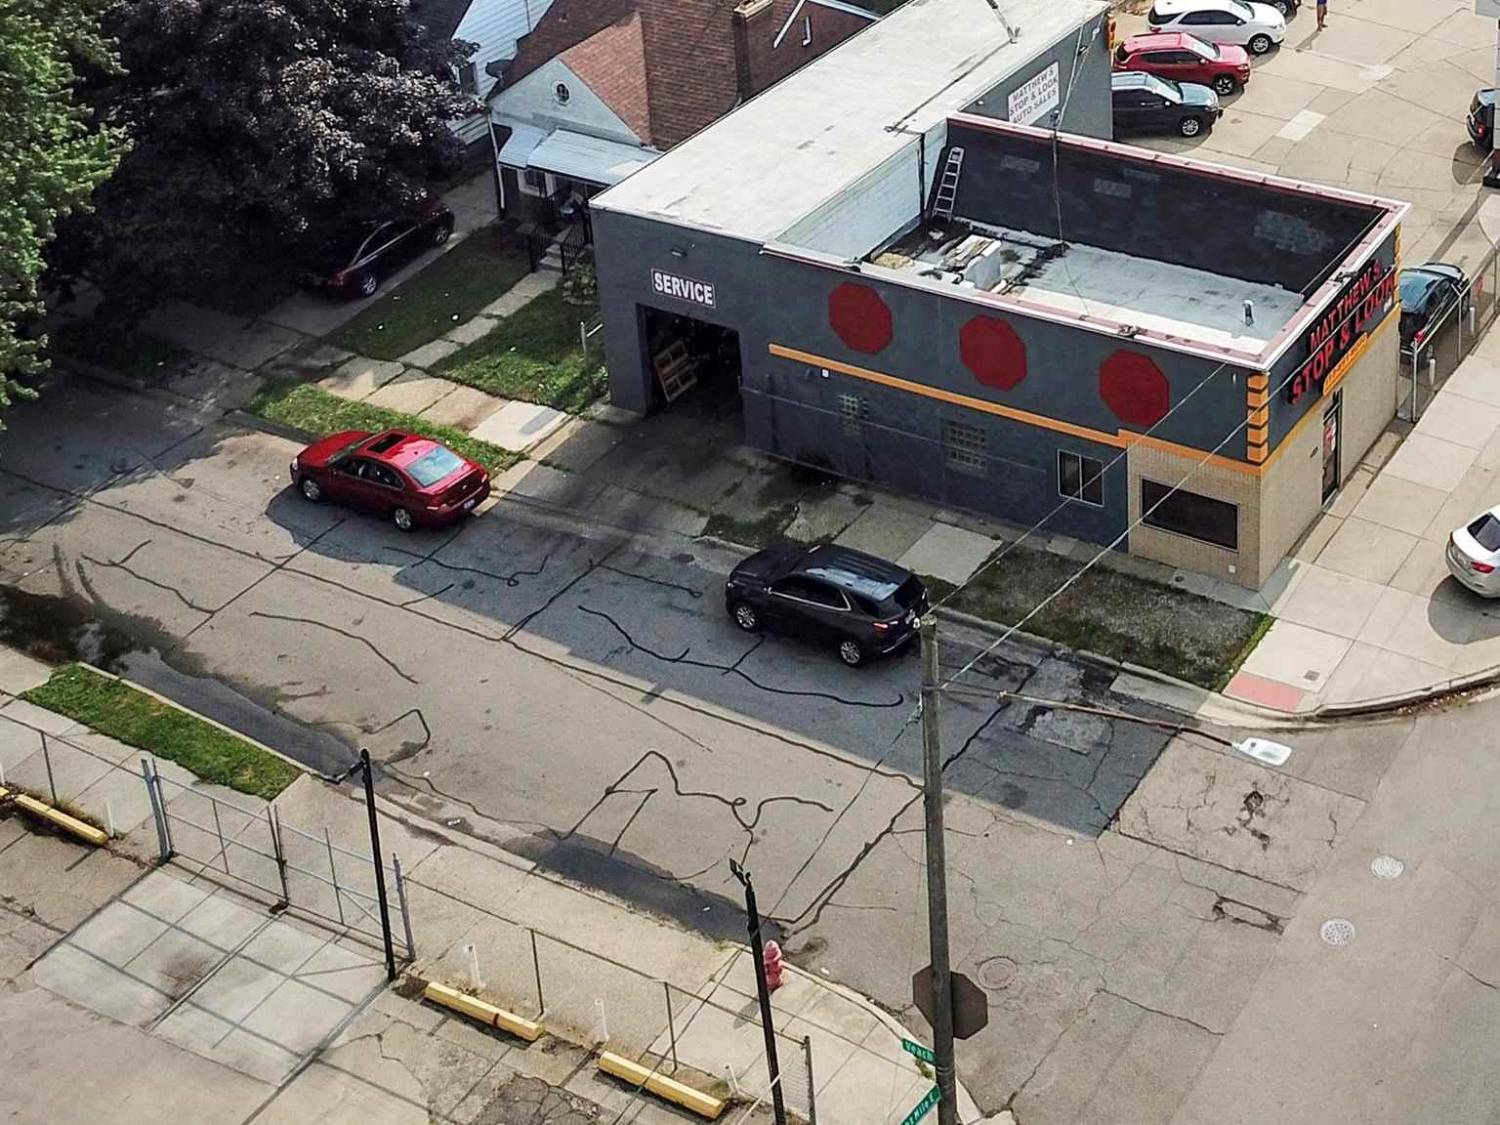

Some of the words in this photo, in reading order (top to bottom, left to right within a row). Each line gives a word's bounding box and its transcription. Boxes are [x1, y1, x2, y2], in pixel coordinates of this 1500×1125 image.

[654, 272, 714, 306] SERVICE
[1291, 337, 1336, 405] STOP
[913, 1100, 929, 1120] Mile
